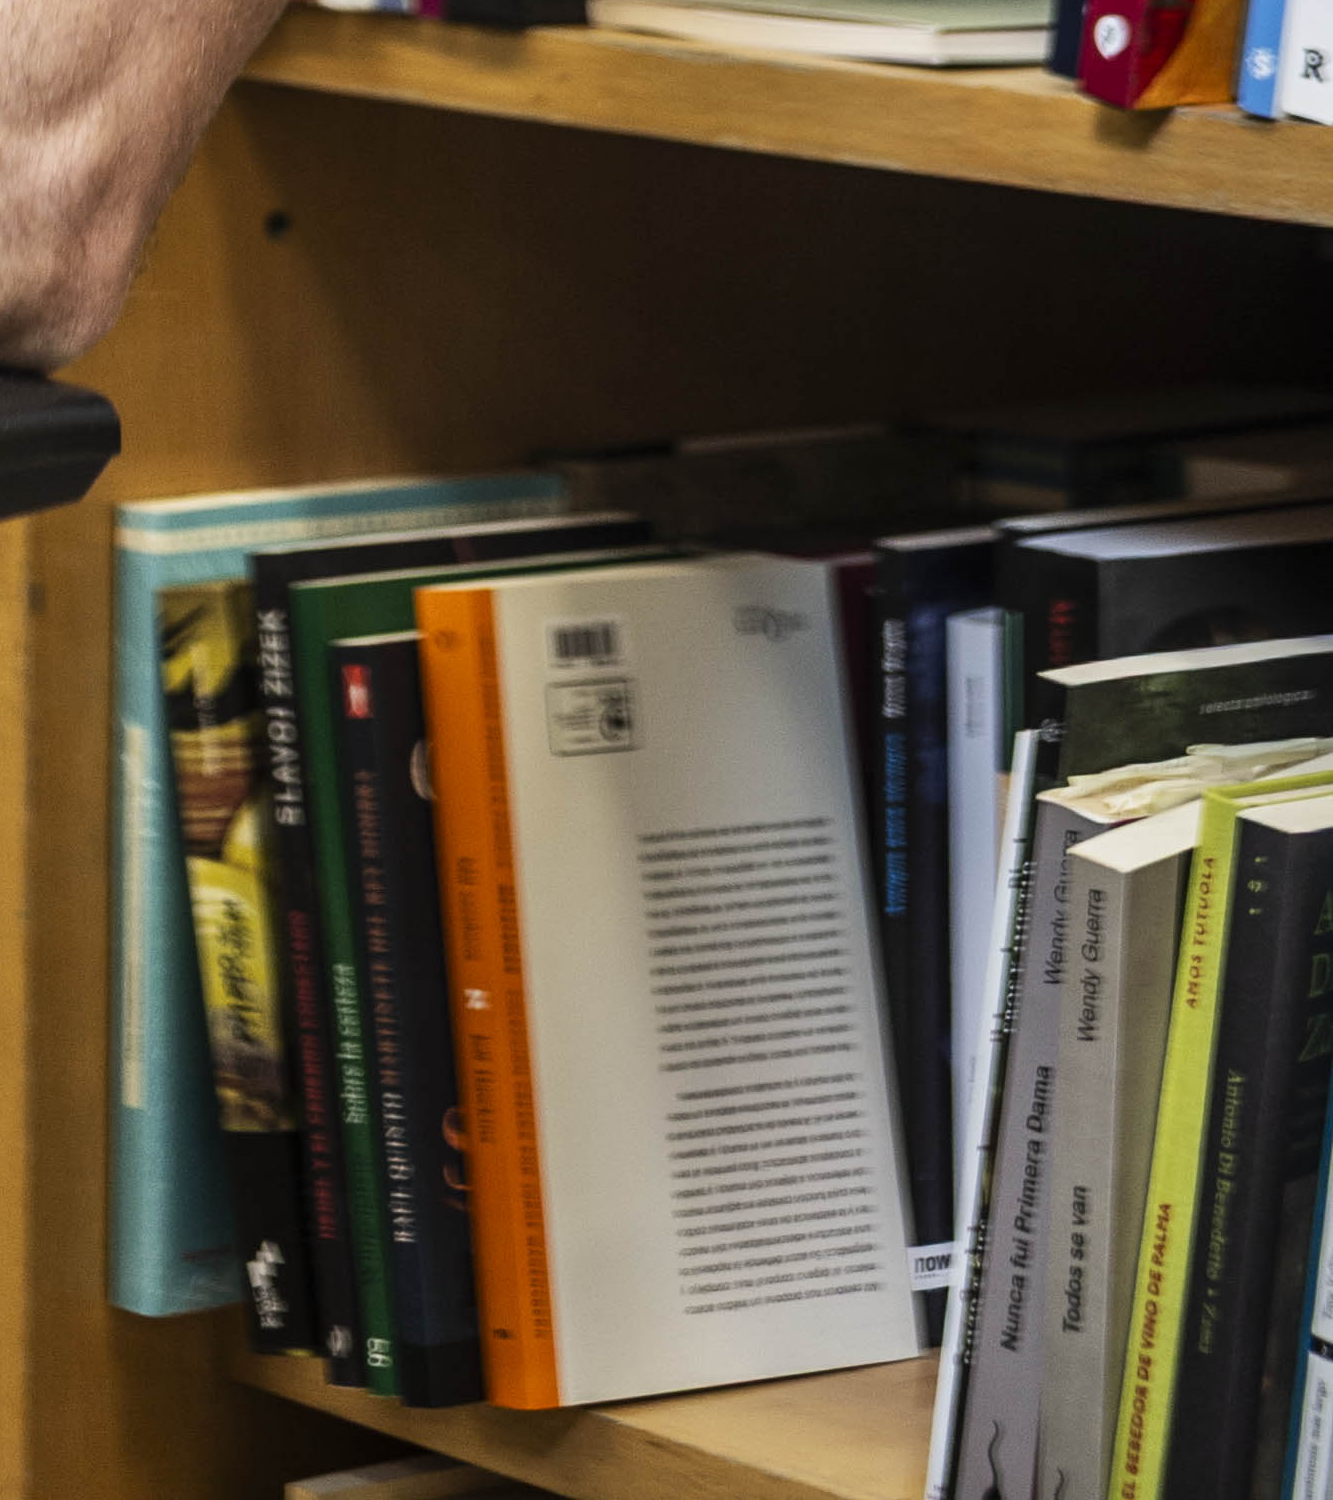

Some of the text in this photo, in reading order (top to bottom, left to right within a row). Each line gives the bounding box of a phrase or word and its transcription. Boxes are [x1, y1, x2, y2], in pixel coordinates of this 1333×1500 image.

[1194, 858, 1215, 946] TUTUOLA
[1186, 954, 1203, 1009] AMOS
[1029, 1066, 1055, 1135] Dama
[1063, 889, 1106, 1333] Todos se van Wendy Guerra
[1221, 1069, 1247, 1148] Antonio
[1016, 1142, 1043, 1234] Primera
[915, 1254, 951, 1273] now
[1014, 1240, 1031, 1271] fui
[1153, 1203, 1172, 1266] PALMA
[1207, 1178, 1233, 1280] Benedetto
[1002, 1277, 1025, 1352] Nunca
[1148, 1270, 1163, 1296] DE
[1141, 1300, 1158, 1348] VINO
[1137, 1355, 1152, 1382] DE
[1127, 1387, 1148, 1476] BEBEDOR
